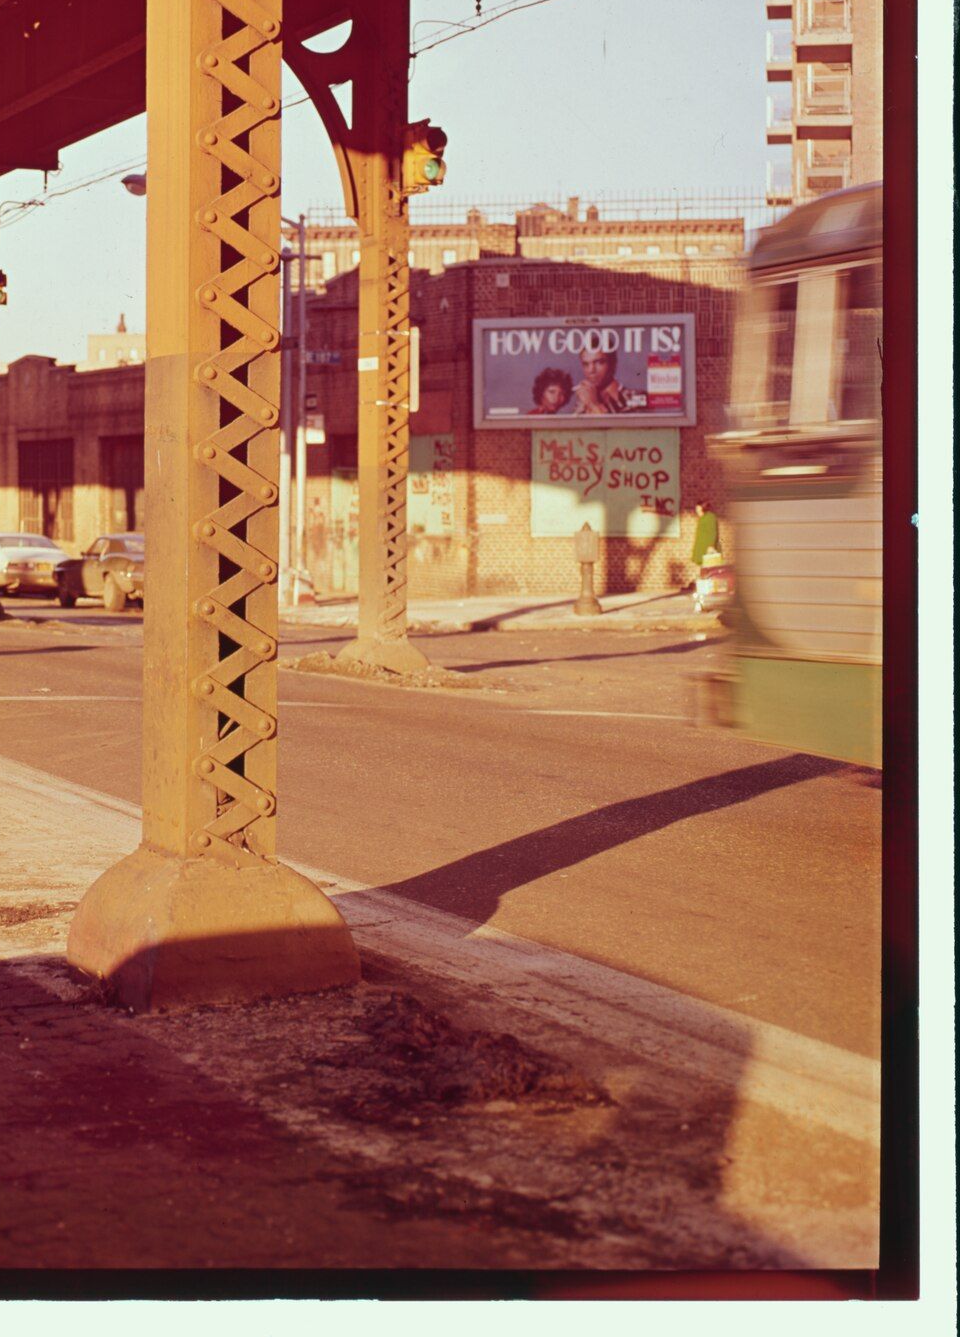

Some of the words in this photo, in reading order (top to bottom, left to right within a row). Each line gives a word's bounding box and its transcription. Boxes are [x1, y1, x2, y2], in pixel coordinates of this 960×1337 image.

[489, 329, 545, 356] HOW
[547, 327, 620, 354] GOOD
[623, 326, 645, 353] IT
[650, 325, 681, 353] IS!
[610, 446, 663, 463] AUTO
[549, 461, 604, 496] BODY
[607, 469, 670, 491] SHOP
[640, 495, 675, 512] INC
